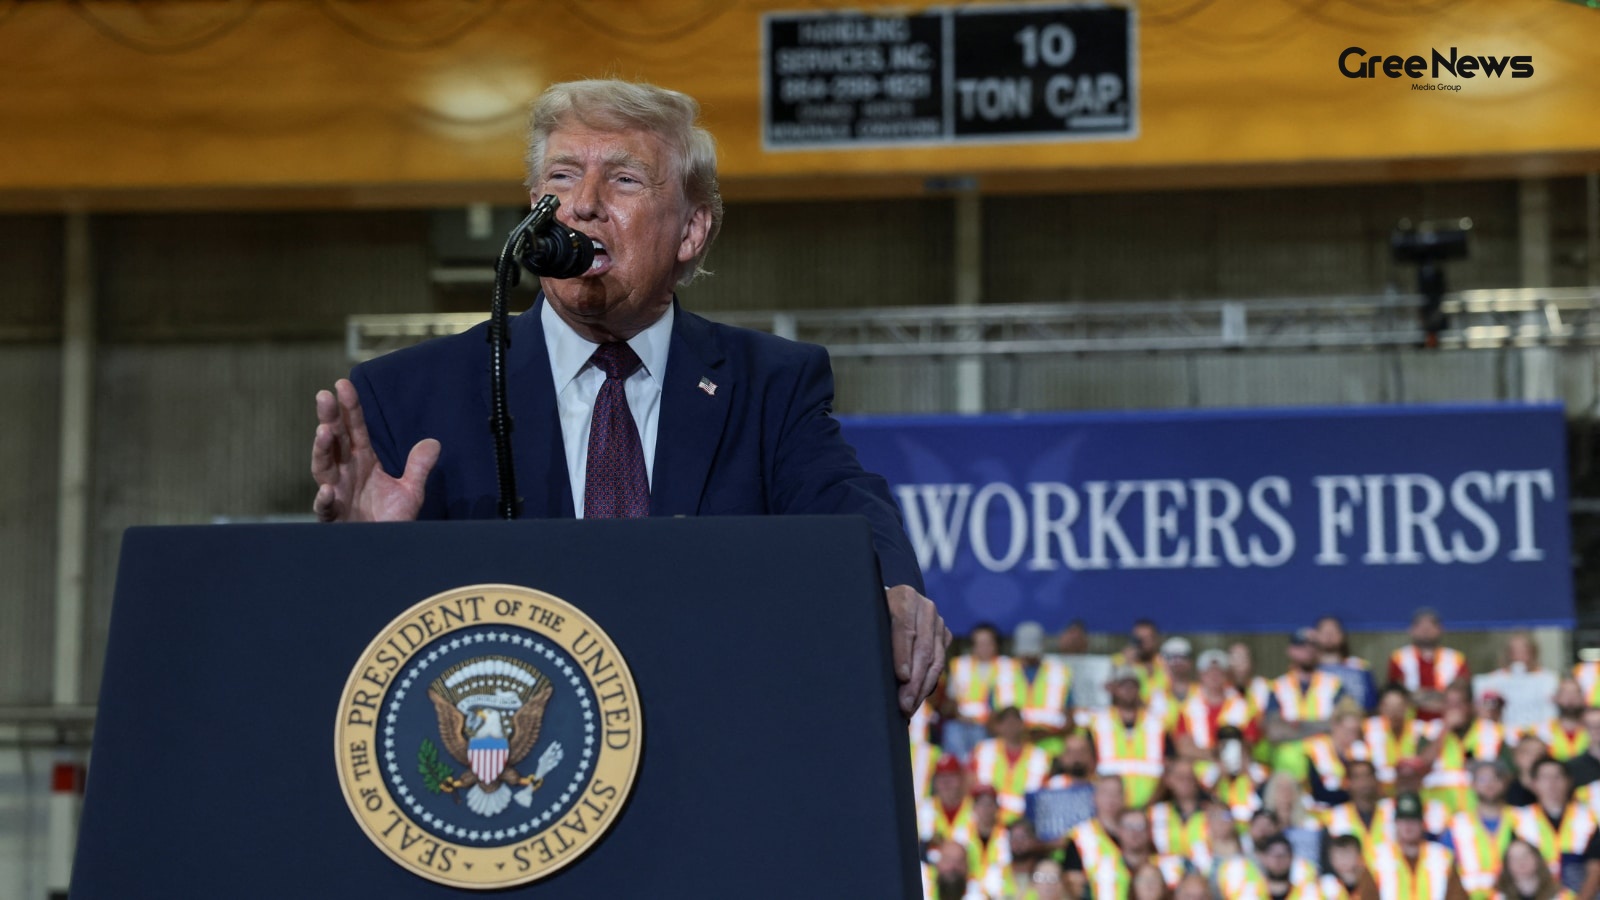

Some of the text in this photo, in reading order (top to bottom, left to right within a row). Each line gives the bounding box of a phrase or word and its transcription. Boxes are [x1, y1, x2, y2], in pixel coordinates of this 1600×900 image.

[1015, 23, 1076, 67] 10
[957, 73, 1127, 120] TON CAP.
[896, 468, 1555, 573] WORKERS FIRST
[348, 596, 630, 872] SEAL OF THE PRESIDENT OF THE UNITED STATES
